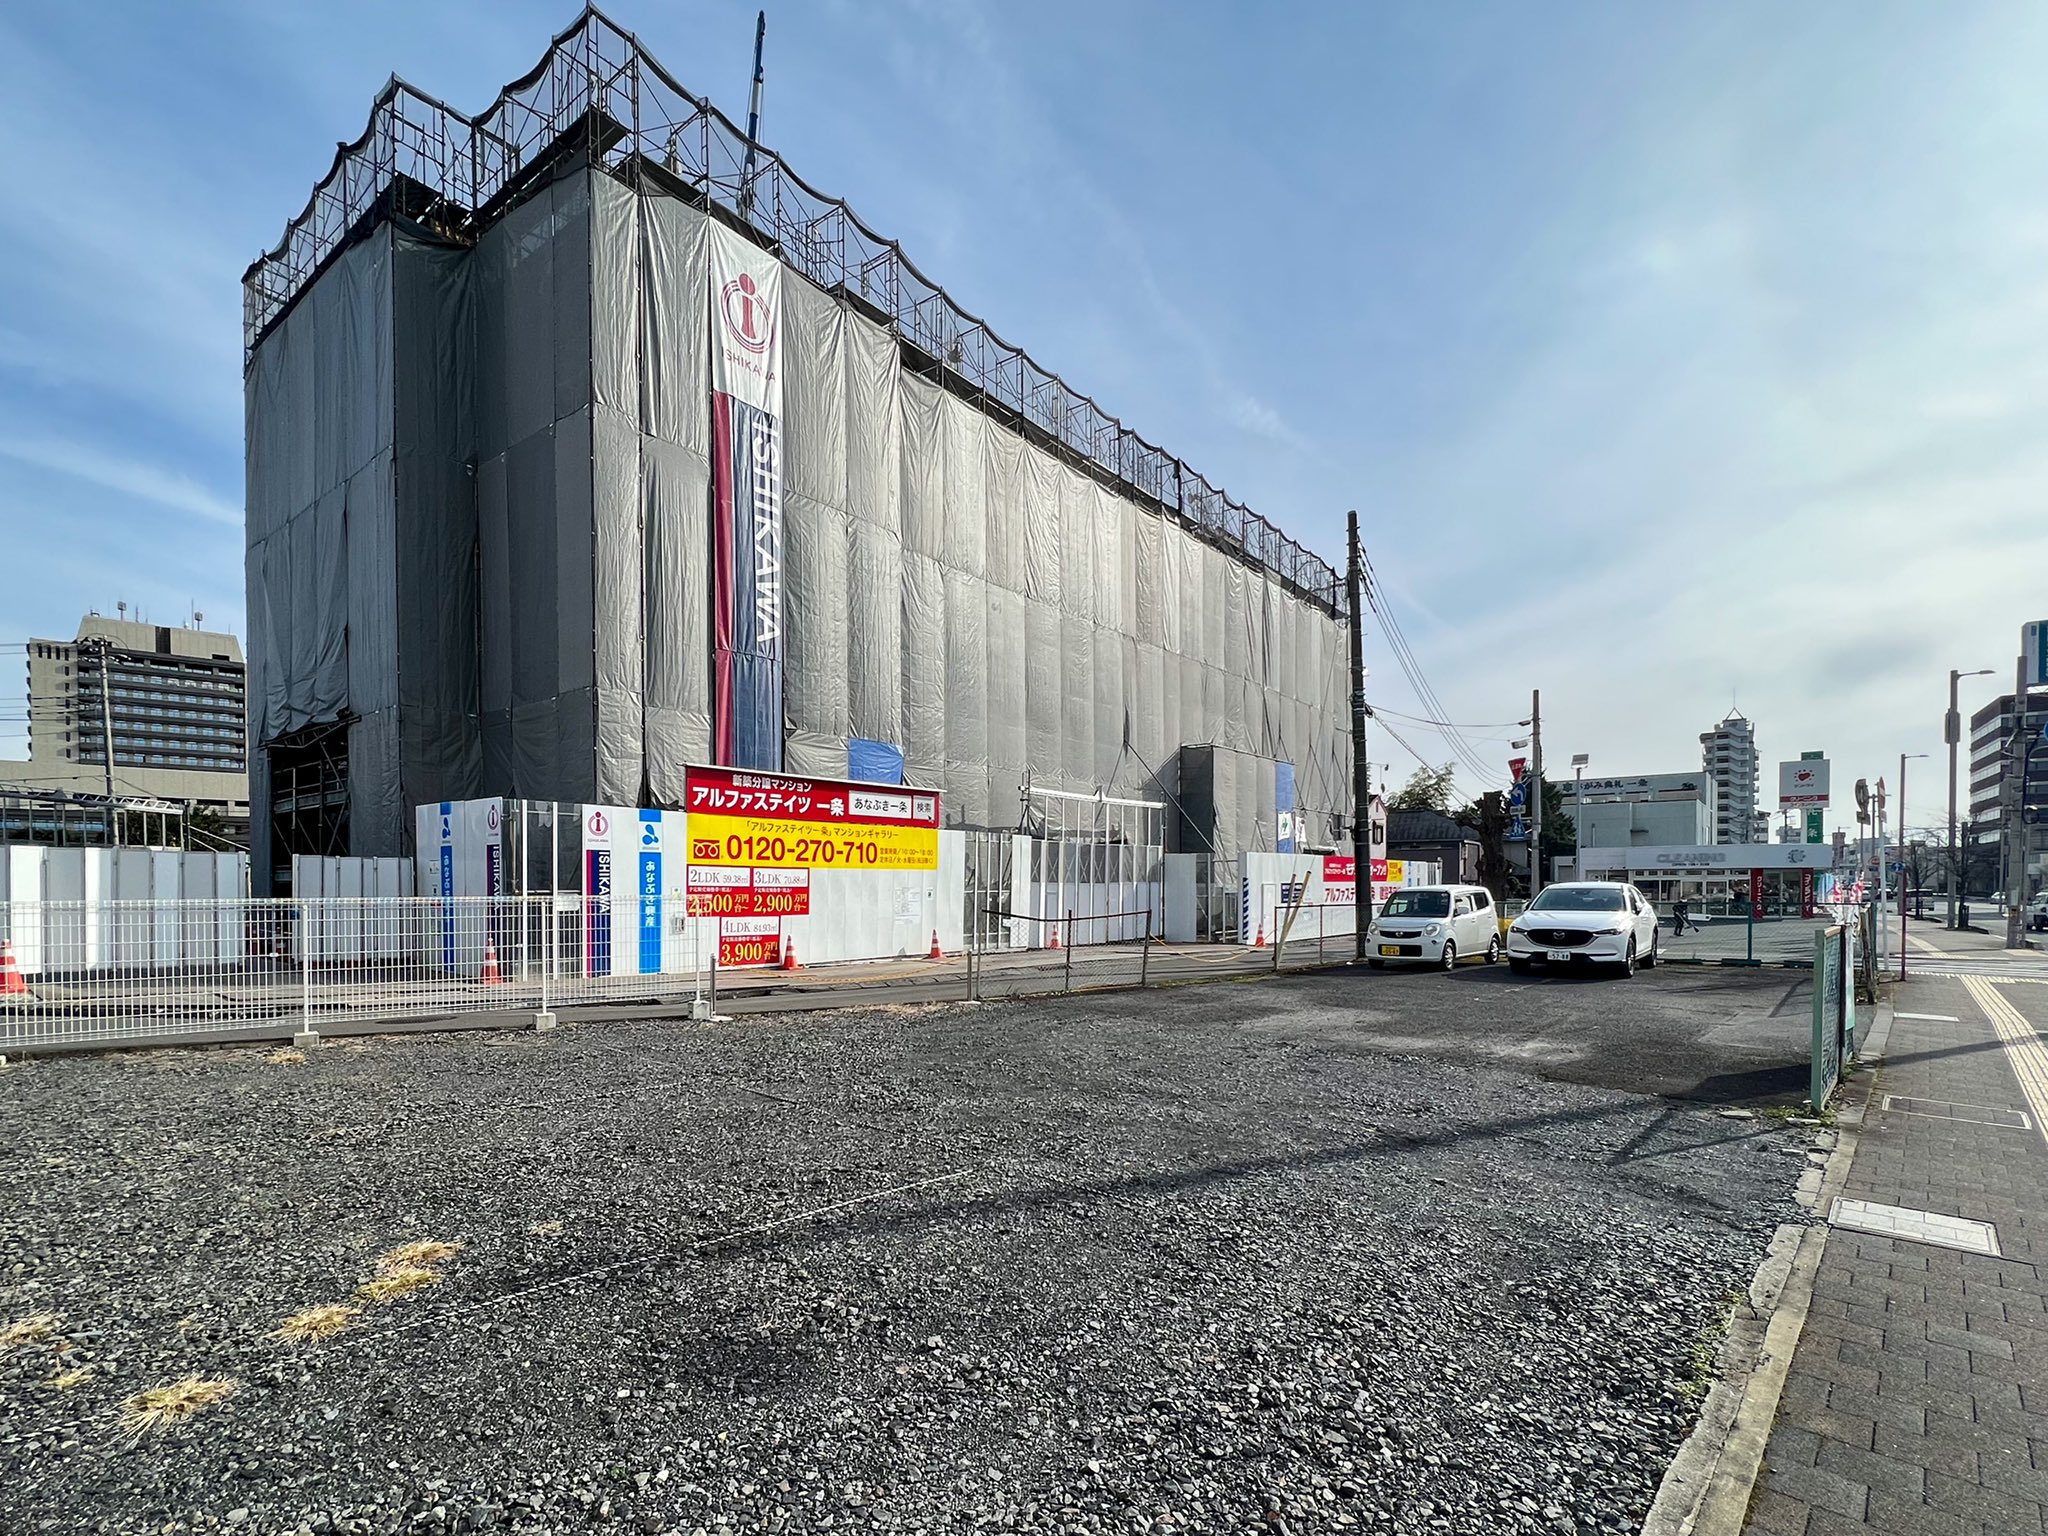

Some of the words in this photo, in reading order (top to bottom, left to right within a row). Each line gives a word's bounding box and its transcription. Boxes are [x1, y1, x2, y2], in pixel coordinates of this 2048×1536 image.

[752, 420, 781, 643] ISHIKAWA
[732, 774, 812, 793] 新築分譲マンション
[692, 786, 811, 814] アルファステイツ
[816, 797, 845, 817] 一条
[854, 798, 908, 813] あなぶき一条
[916, 802, 932, 813] 検索
[727, 834, 878, 864] 0120-270-710
[690, 869, 720, 884] 2LDK
[755, 870, 782, 884] 3LDK
[753, 894, 793, 915] 2,900
[723, 919, 751, 933] 4LDK
[721, 942, 763, 964] 3,900
